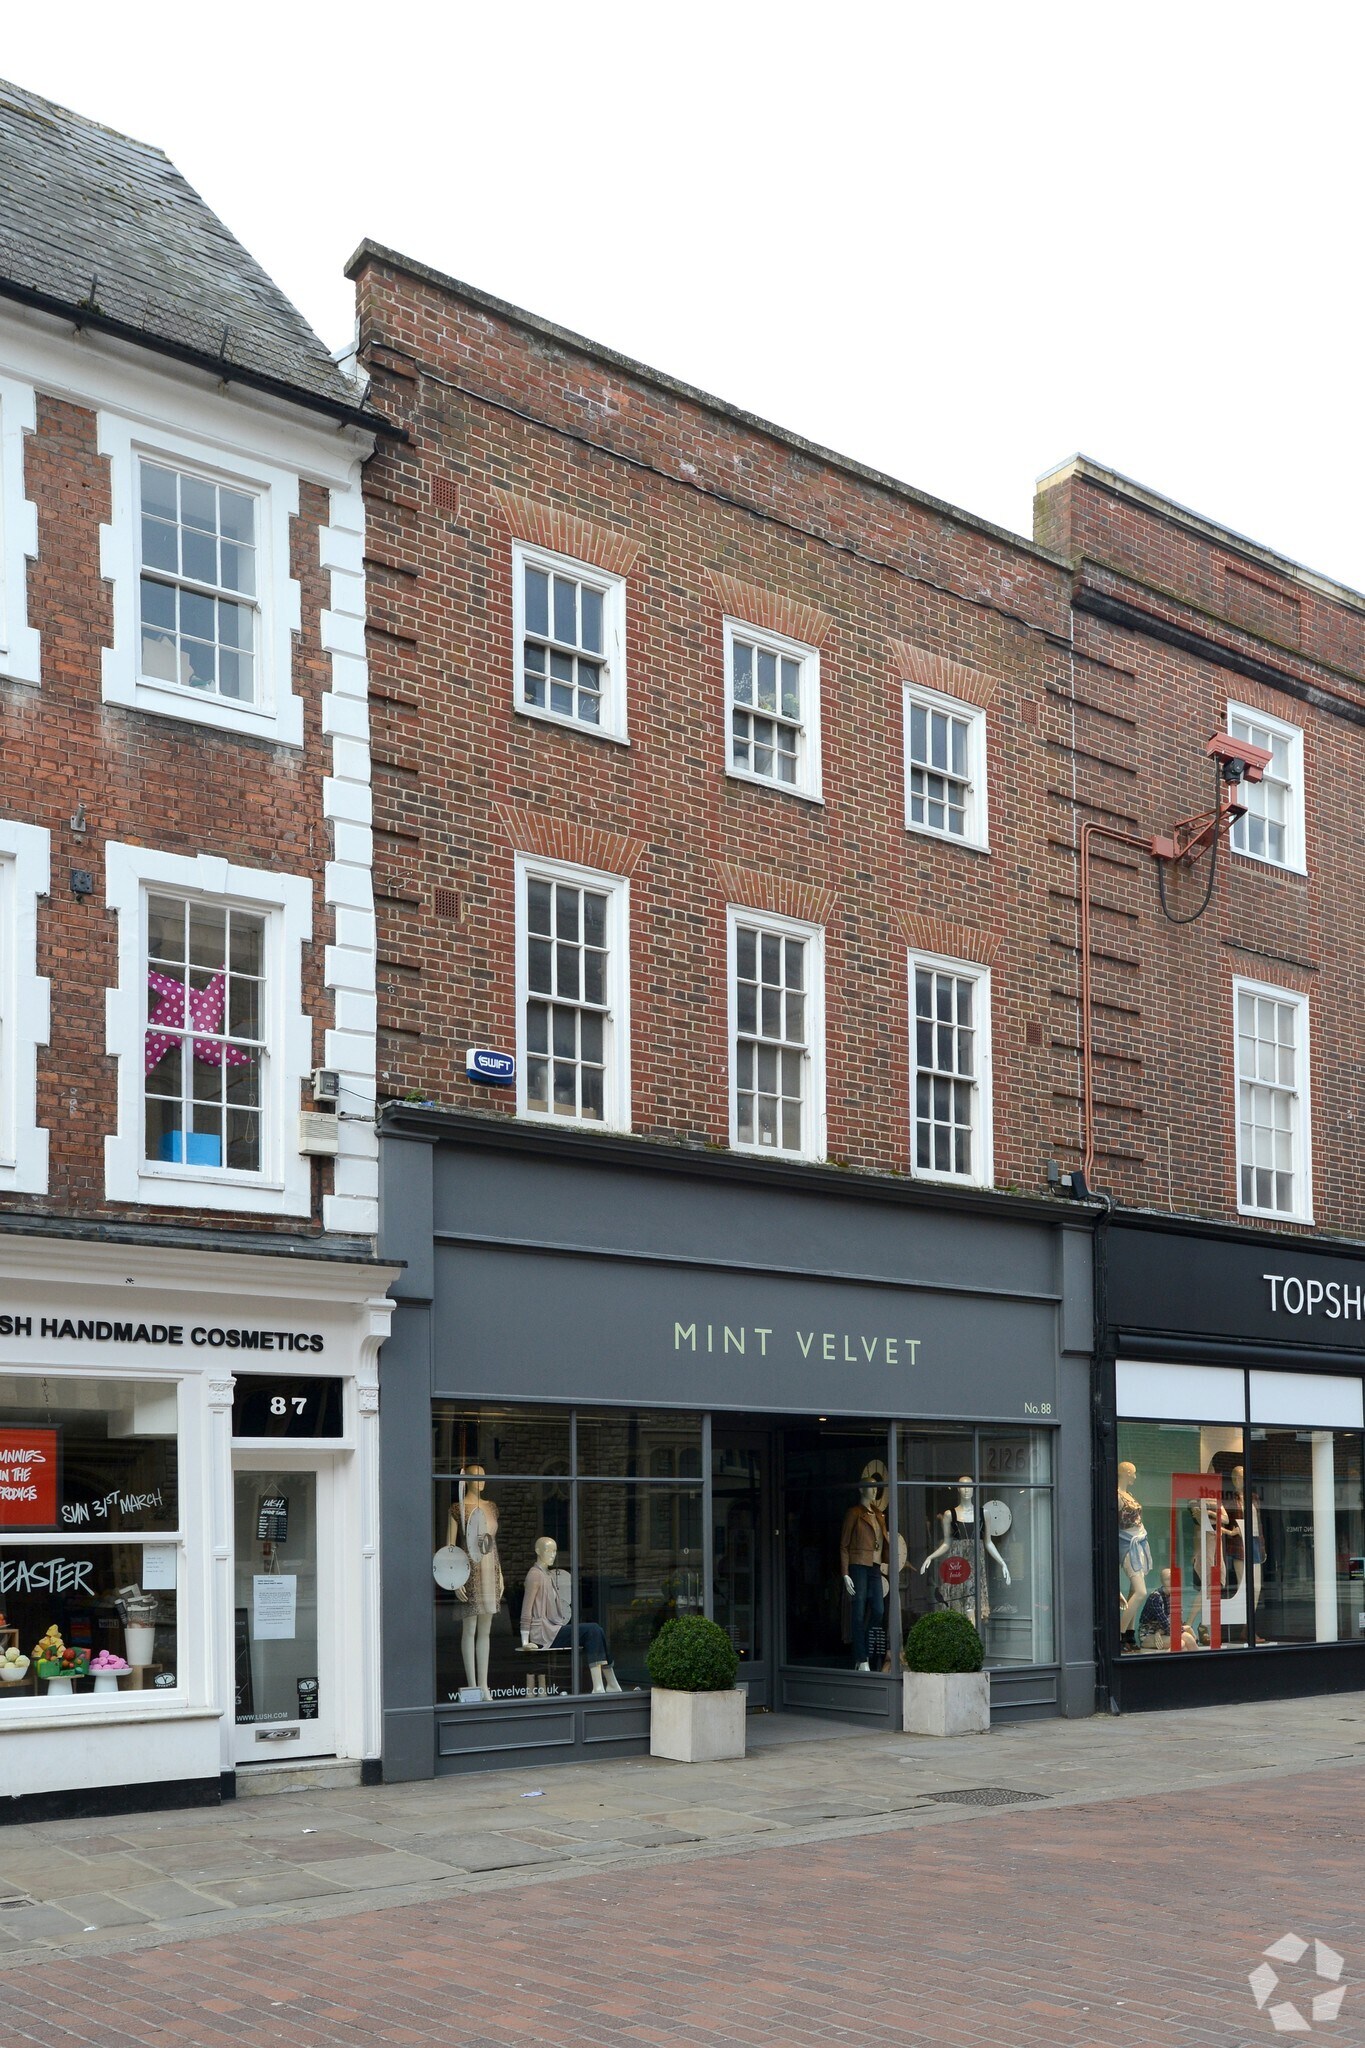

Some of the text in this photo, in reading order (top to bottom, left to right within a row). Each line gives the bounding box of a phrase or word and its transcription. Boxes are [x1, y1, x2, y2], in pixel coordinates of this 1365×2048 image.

[478, 1055, 511, 1071] SWIFT
[1263, 1274, 1365, 1320] TOPSH
[41, 1318, 183, 1344] HANDMADE
[191, 1327, 324, 1352] COSMETICS
[674, 1322, 921, 1365] MINT VELVET
[270, 1396, 307, 1415] 87
[11, 1466, 33, 1482] THE
[61, 1502, 90, 1524] SUN
[119, 1488, 163, 1515] MARCH
[0, 1557, 95, 1597] EASTER
